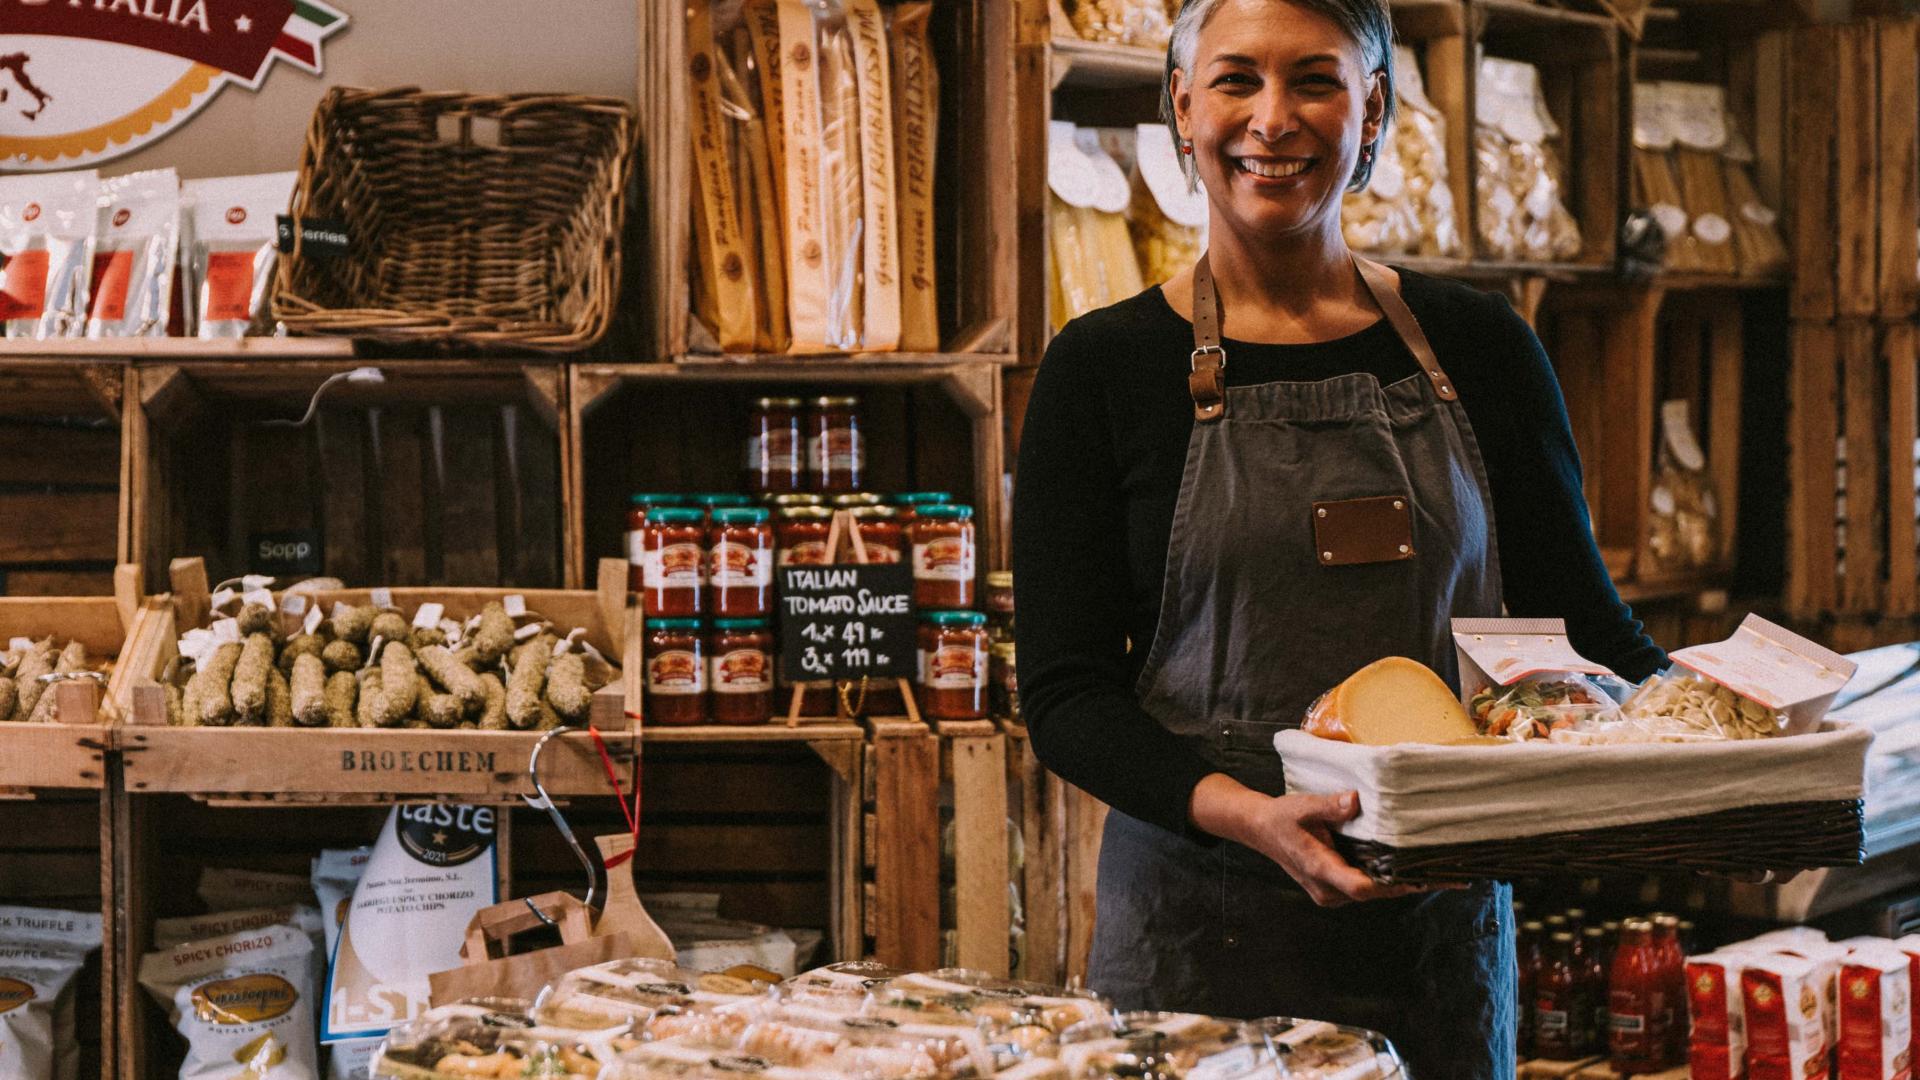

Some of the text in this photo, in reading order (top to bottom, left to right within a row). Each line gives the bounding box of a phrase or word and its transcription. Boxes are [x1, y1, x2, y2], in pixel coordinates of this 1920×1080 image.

[296, 226, 349, 246] erries
[259, 541, 312, 560] Sopp
[787, 569, 857, 590] ITALIAN
[784, 588, 910, 616] TOMATO SAUCE
[842, 621, 865, 645] 49
[342, 750, 496, 772] BROECHEM
[402, 801, 494, 834] taste
[422, 849, 447, 862] 2021
[16, 917, 74, 931] TRUFFLE
[191, 912, 291, 936] SPICY CHORIZO
[173, 936, 273, 967] SPICY CHORIZO
